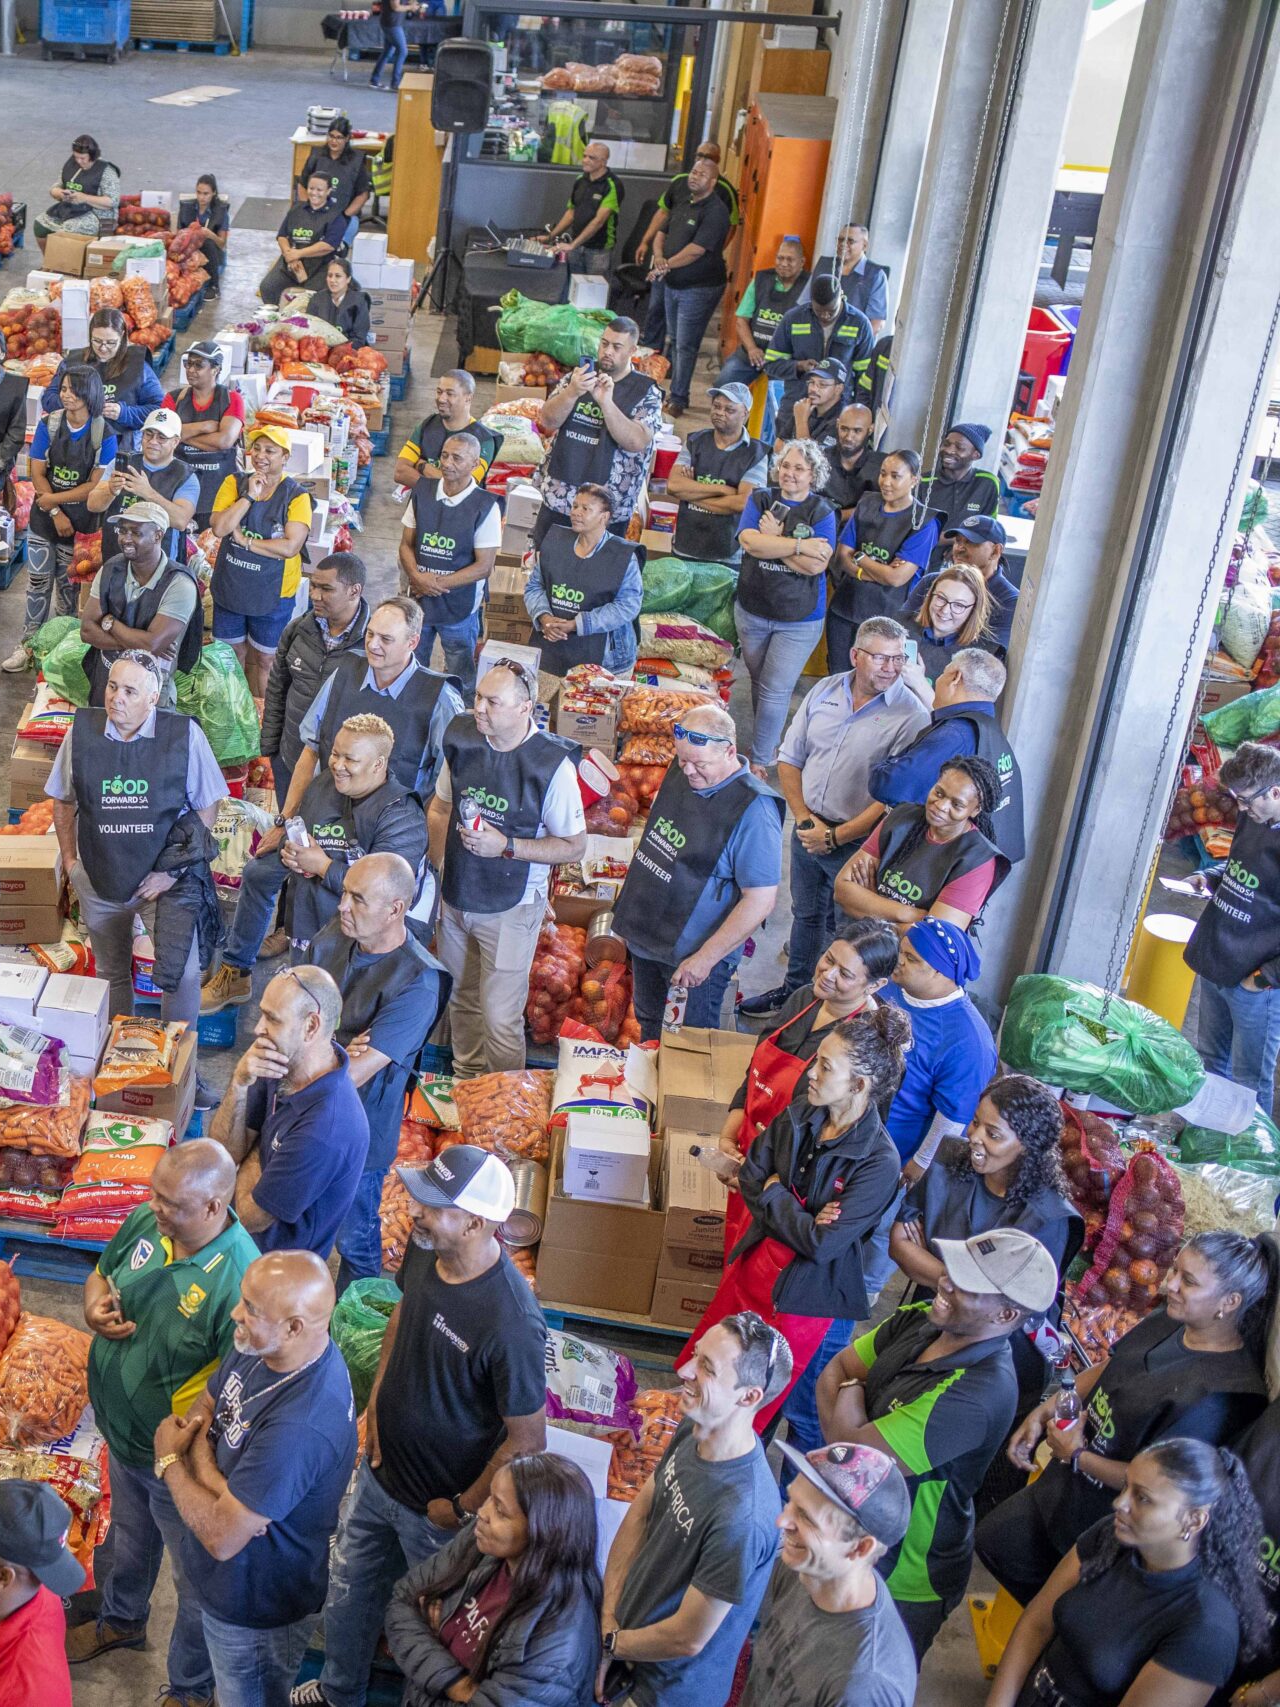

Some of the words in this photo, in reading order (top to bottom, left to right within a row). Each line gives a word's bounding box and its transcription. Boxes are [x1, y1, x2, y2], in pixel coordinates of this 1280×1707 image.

[422, 530, 455, 549] FOOD
[551, 583, 584, 603] FOOD
[102, 775, 149, 795] FOOD
[102, 796, 138, 804] FORWARD
[98, 823, 154, 834] VOLUNTEER
[312, 822, 346, 838] FOO
[653, 816, 686, 849] FOOD
[648, 830, 673, 853] FORWARD
[635, 848, 672, 883] VOLUNTEER
[1227, 859, 1260, 889] FOOD
[882, 867, 923, 901] FOOD
[573, 1045, 628, 1059] IMPAL
[123, 1091, 153, 1103] Royco
[691, 1256, 723, 1267] Royco
[671, 1480, 694, 1535] AFRICA
